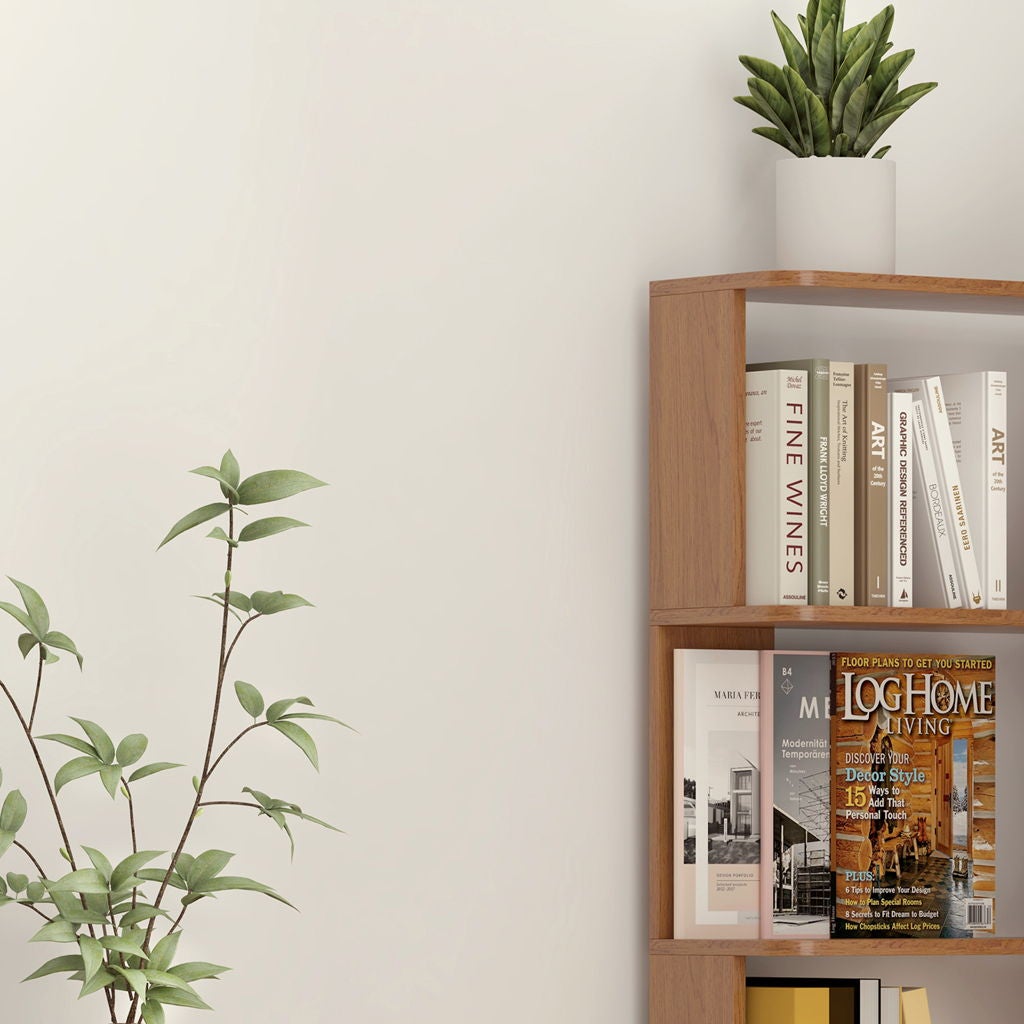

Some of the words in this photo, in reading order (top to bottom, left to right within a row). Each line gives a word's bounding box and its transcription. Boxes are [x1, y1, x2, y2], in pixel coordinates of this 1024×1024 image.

[786, 403, 803, 465] FINE
[871, 421, 885, 460] ART
[899, 412, 907, 457] GRAPHIC
[819, 436, 828, 463] FRANK
[991, 428, 1005, 465] ART
[819, 465, 828, 491] LLOYD
[870, 480, 886, 488] Century
[899, 459, 907, 497] DESIGN
[991, 485, 1006, 493] Century
[819, 494, 828, 527] WRIGHT
[928, 483, 946, 538] BORDEAUX
[951, 485, 966, 527] SAARINEN
[786, 480, 803, 573] WINES
[899, 500, 907, 567] REFERENCED
[960, 529, 971, 551] EERO
[841, 657, 870, 667] FLOOR
[872, 658, 900, 668] PLANS
[901, 658, 914, 668] TO
[916, 658, 932, 669] GET
[934, 659, 953, 669] YOU
[954, 659, 993, 670] STARTED
[714, 690, 742, 700] MARIA
[887, 717, 952, 736] LIVING
[782, 738, 828, 748] Modernität
[845, 752, 886, 765] DISCOVER
[887, 752, 910, 765] YOUR
[845, 768, 886, 782] Decor
[889, 768, 925, 785] Style
[845, 786, 867, 807] 15
[869, 786, 889, 796] Ways
[891, 786, 900, 795] to
[868, 797, 884, 807] Add
[887, 797, 905, 807] That
[845, 810, 881, 820] Personal
[884, 810, 907, 820] Touch
[845, 871, 875, 882] PLUS:
[845, 886, 850, 894] 6
[851, 886, 863, 895] Tips
[872, 886, 896, 895] Improve
[897, 886, 910, 894] Your
[911, 886, 931, 896] Design
[845, 898, 858, 906] How
[866, 898, 880, 906] Plan
[880, 898, 902, 907] Special
[902, 898, 923, 906] Rooms
[845, 910, 850, 918] 8
[851, 910, 873, 918] Secrets
[882, 910, 891, 918] Fit
[891, 910, 911, 918] Dream
[918, 910, 940, 920] Budget
[845, 923, 858, 931] How
[859, 923, 890, 931] Chopsticks
[891, 923, 909, 931] Affect
[910, 923, 921, 932] Log
[922, 923, 940, 931] Prices
